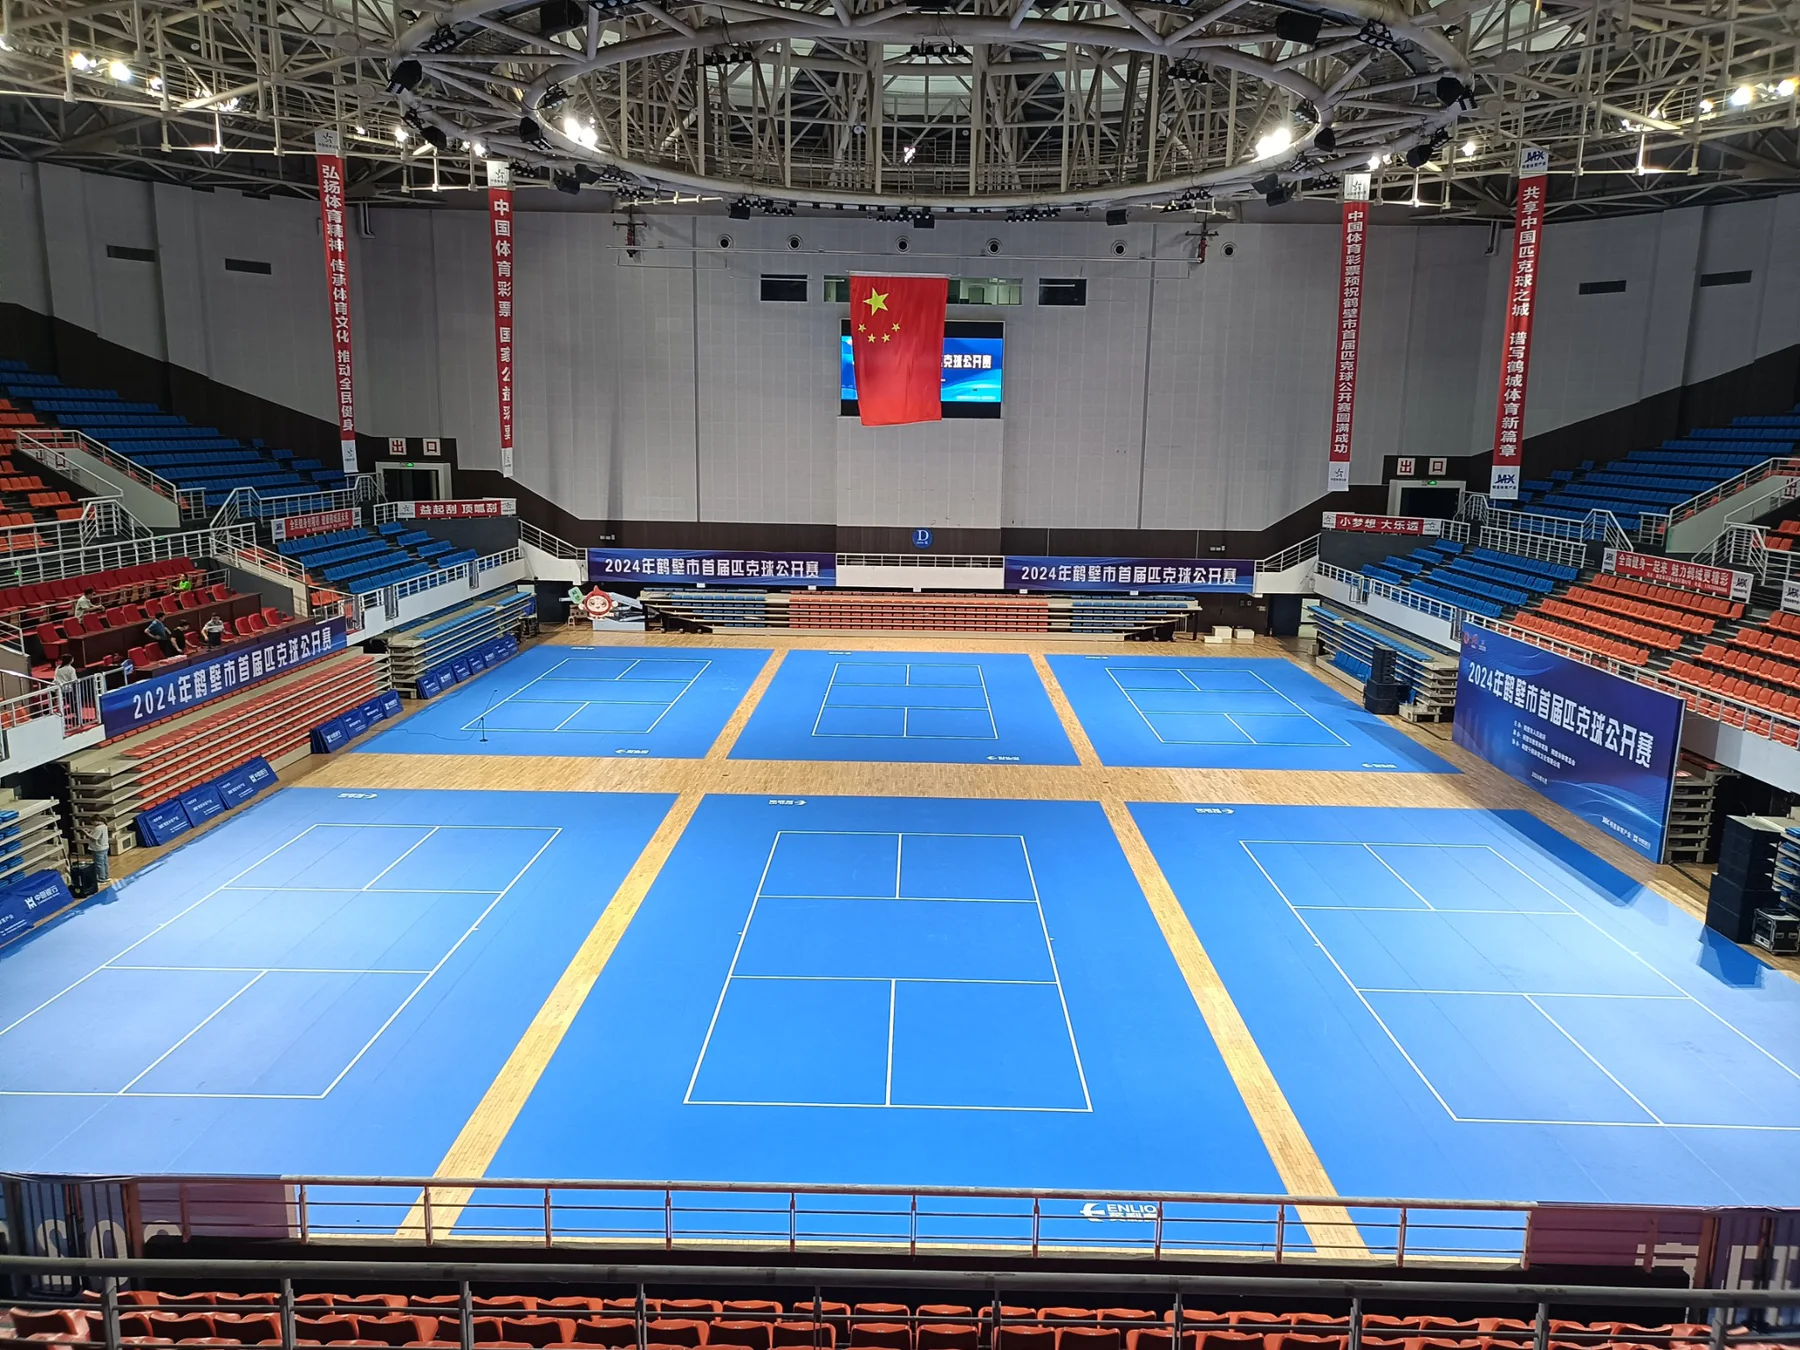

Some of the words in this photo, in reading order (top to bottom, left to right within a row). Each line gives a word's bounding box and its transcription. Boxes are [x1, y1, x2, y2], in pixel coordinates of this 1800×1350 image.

[322, 164, 345, 252] 弘扬体育精神
[494, 198, 511, 317] 中国体育彩票
[1511, 185, 1541, 317] 共享中国匹克球之城
[331, 259, 349, 343] 传承体育文化
[1334, 210, 1364, 454] 中国体育彩票预祝鹤壁市首届匹克球公开赛圆满成功
[942, 354, 992, 369] 克球公开赛
[1499, 331, 1528, 457] 谱写鹤城体育新篇章
[391, 440, 438, 453] 出口
[1400, 460, 1443, 473] 出口
[420, 504, 457, 515] 益起刮
[1340, 517, 1376, 528] 小梦想
[917, 529, 930, 541] D
[605, 557, 819, 578] 2024年鹤壁市首届匹克球公开赛
[1021, 564, 1237, 585] 2024年鹤壁市首届匹克球公开赛
[133, 626, 333, 720] 2024年鹤壁市首届匹克球公开赛
[1468, 662, 1655, 769] 2024年鹤壁市首届匹克球公开赛
[1106, 1203, 1157, 1214] ENLIO
